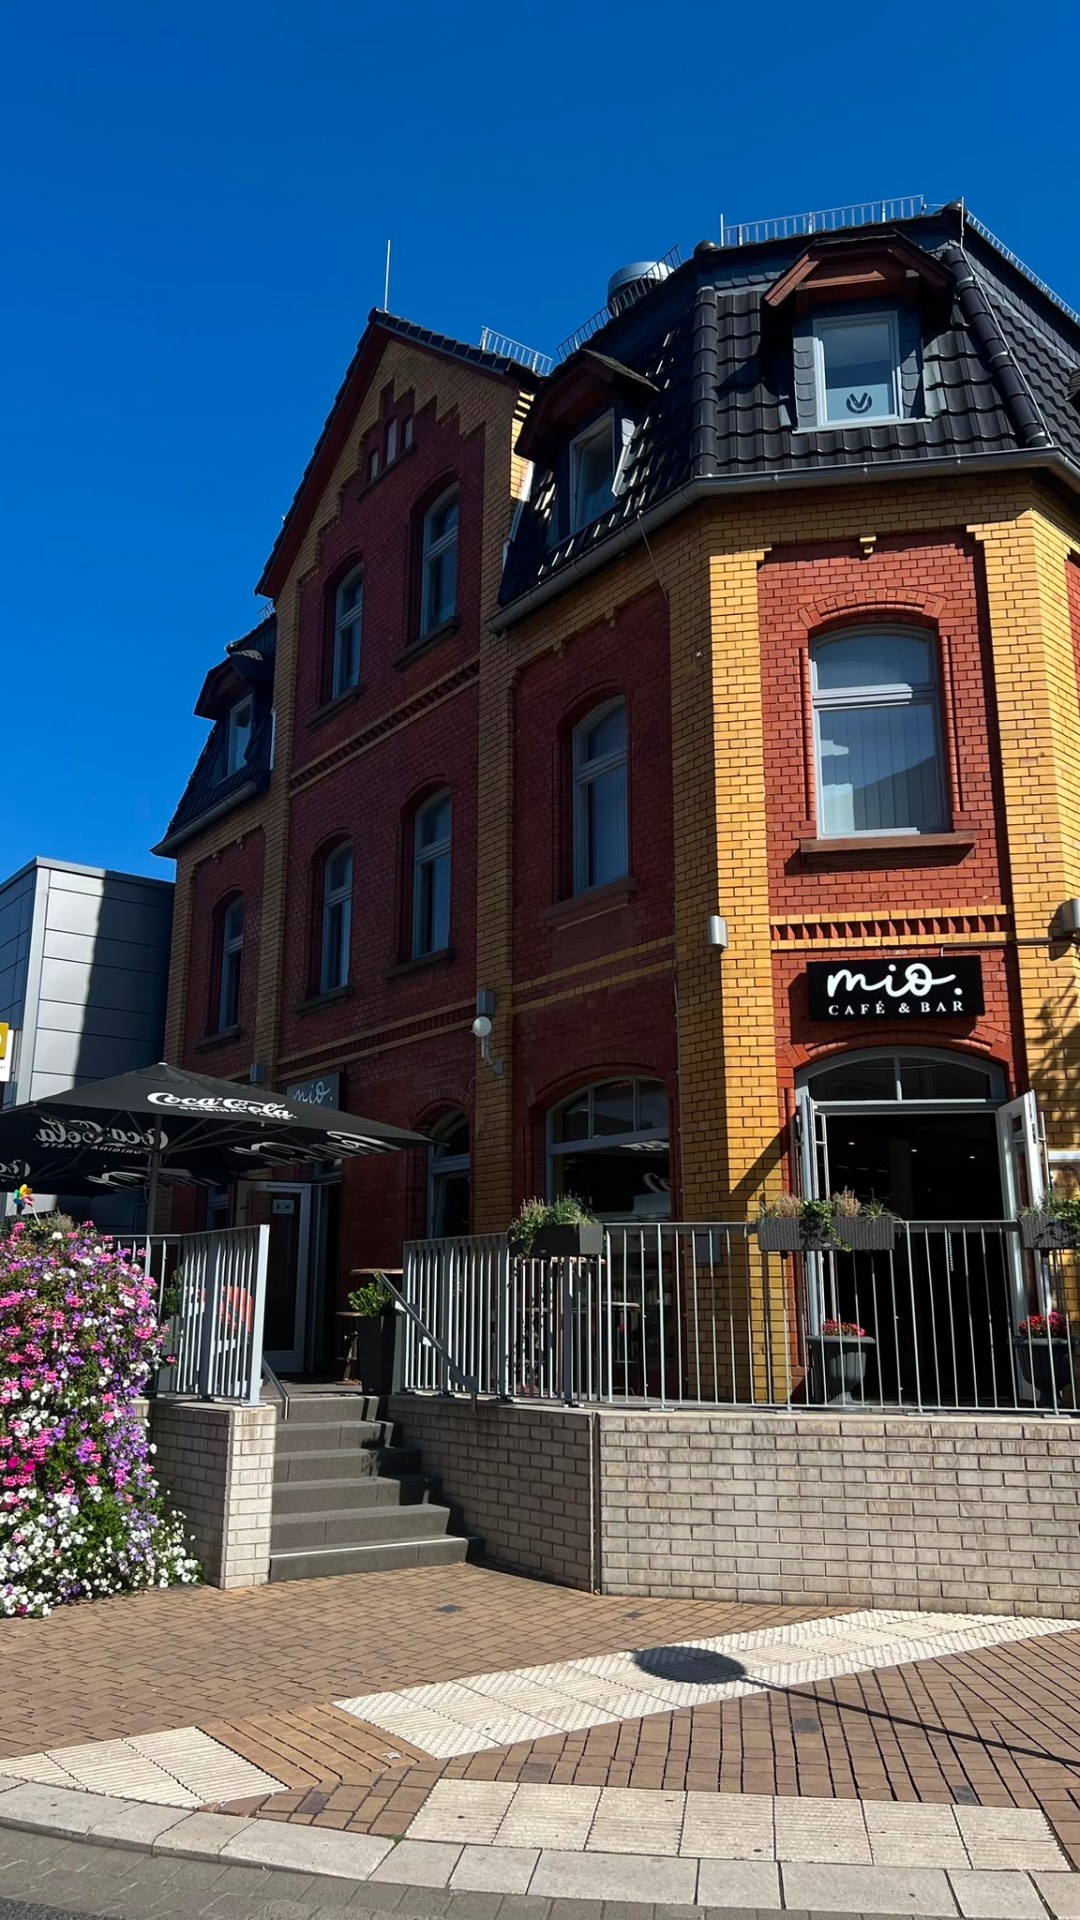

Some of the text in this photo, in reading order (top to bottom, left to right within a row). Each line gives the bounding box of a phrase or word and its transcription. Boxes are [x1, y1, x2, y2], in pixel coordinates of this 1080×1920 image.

[827, 963, 963, 998] mio.
[828, 1000, 964, 1016] CAFÉ & BAR
[147, 1092, 297, 1118] Coca-Cola
